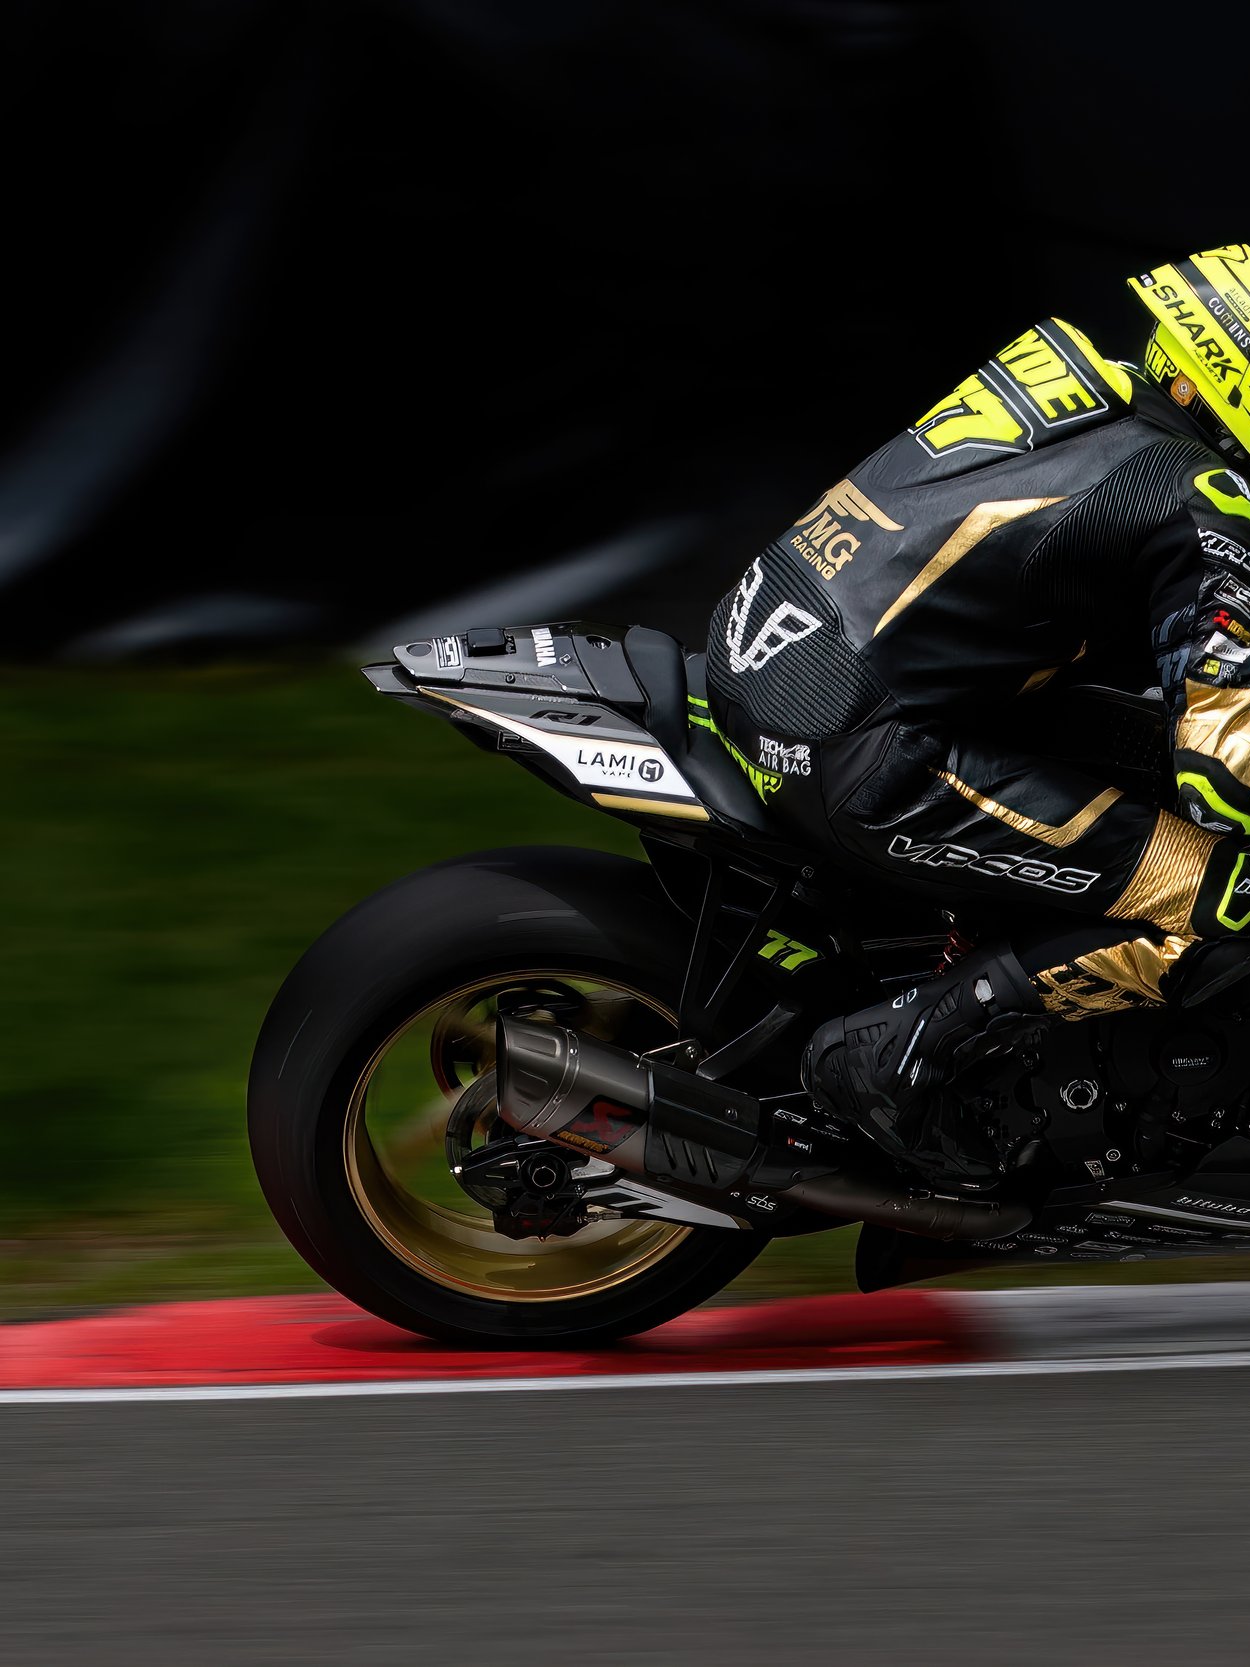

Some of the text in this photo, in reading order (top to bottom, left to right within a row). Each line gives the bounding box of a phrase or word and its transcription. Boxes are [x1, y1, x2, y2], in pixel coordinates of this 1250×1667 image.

[1152, 284, 1243, 382] SHARK
[790, 533, 837, 582] RACING
[801, 511, 862, 572] MG
[577, 749, 636, 772] LAMI
[758, 750, 813, 777] AIR BAG
[758, 930, 818, 972] 77
